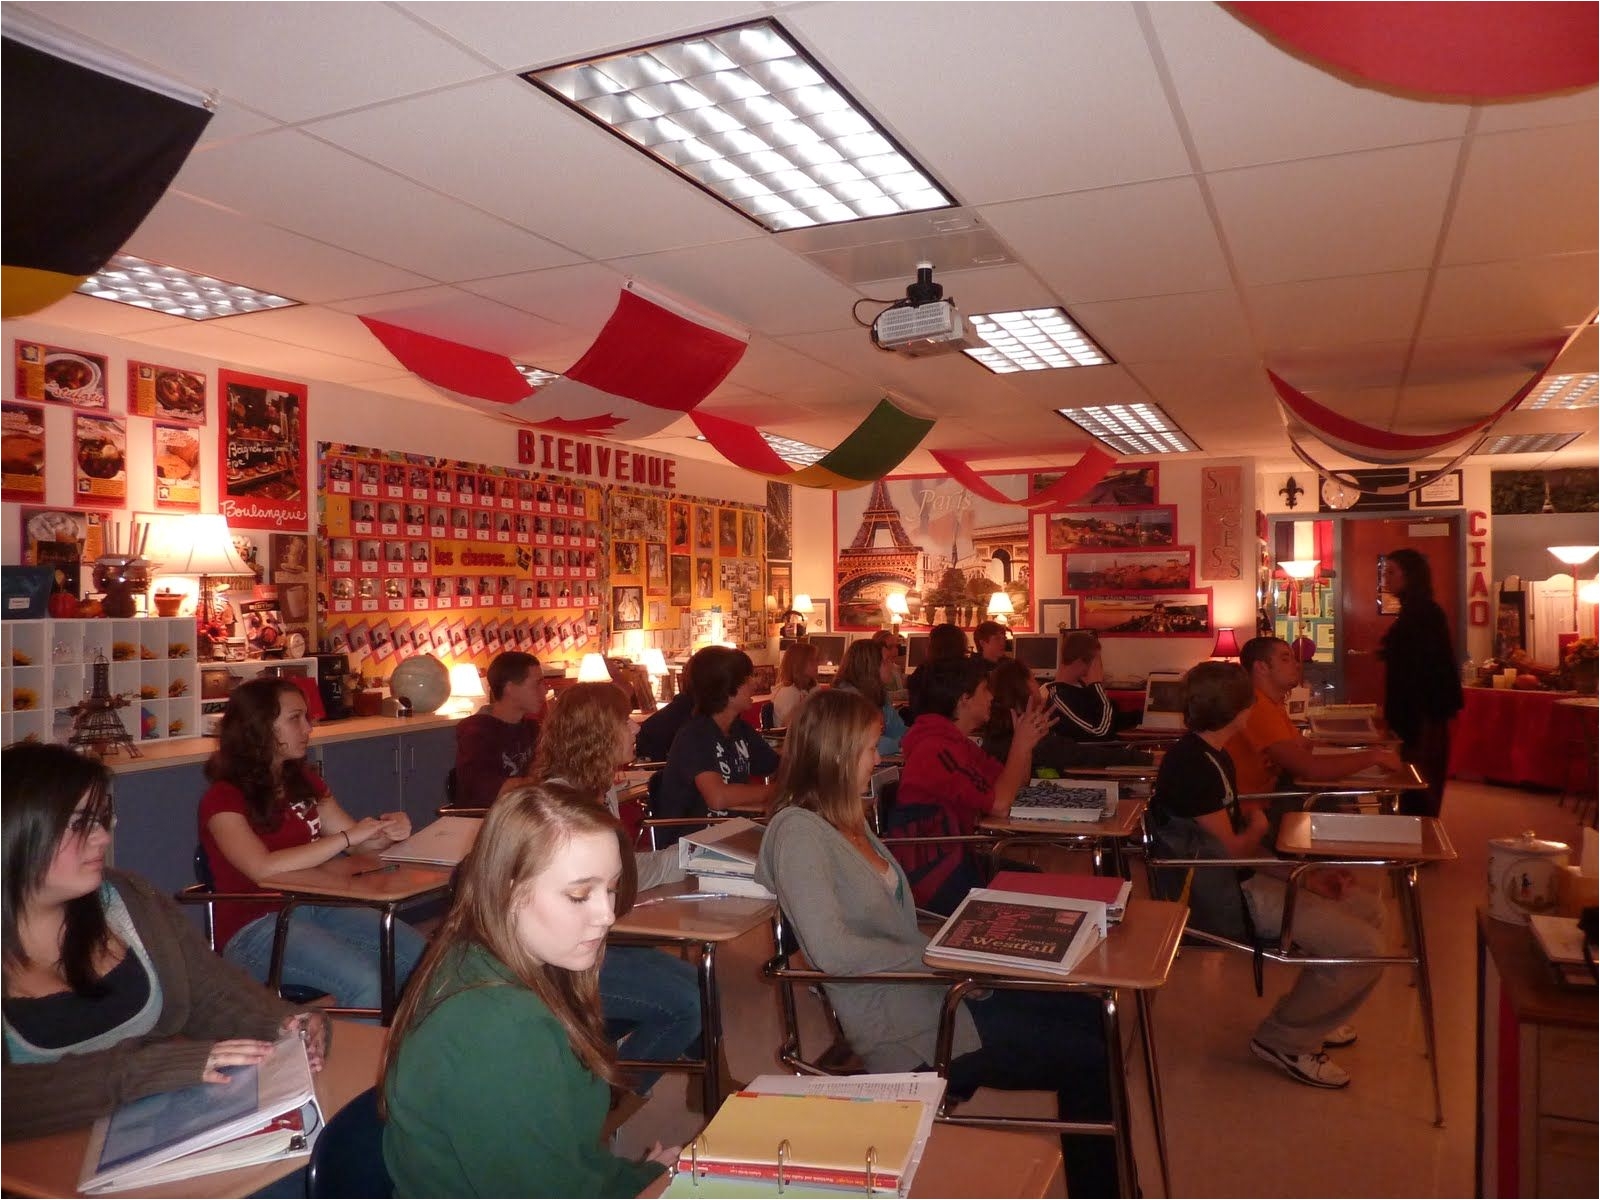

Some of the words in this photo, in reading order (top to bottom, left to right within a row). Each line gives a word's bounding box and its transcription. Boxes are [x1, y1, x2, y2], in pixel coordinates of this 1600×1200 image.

[517, 429, 677, 489] BIENVENUE
[219, 499, 307, 526] Boulangerie
[919, 488, 972, 516] Paris
[1468, 511, 1490, 627] CIAO
[971, 936, 1057, 955] Westfall
